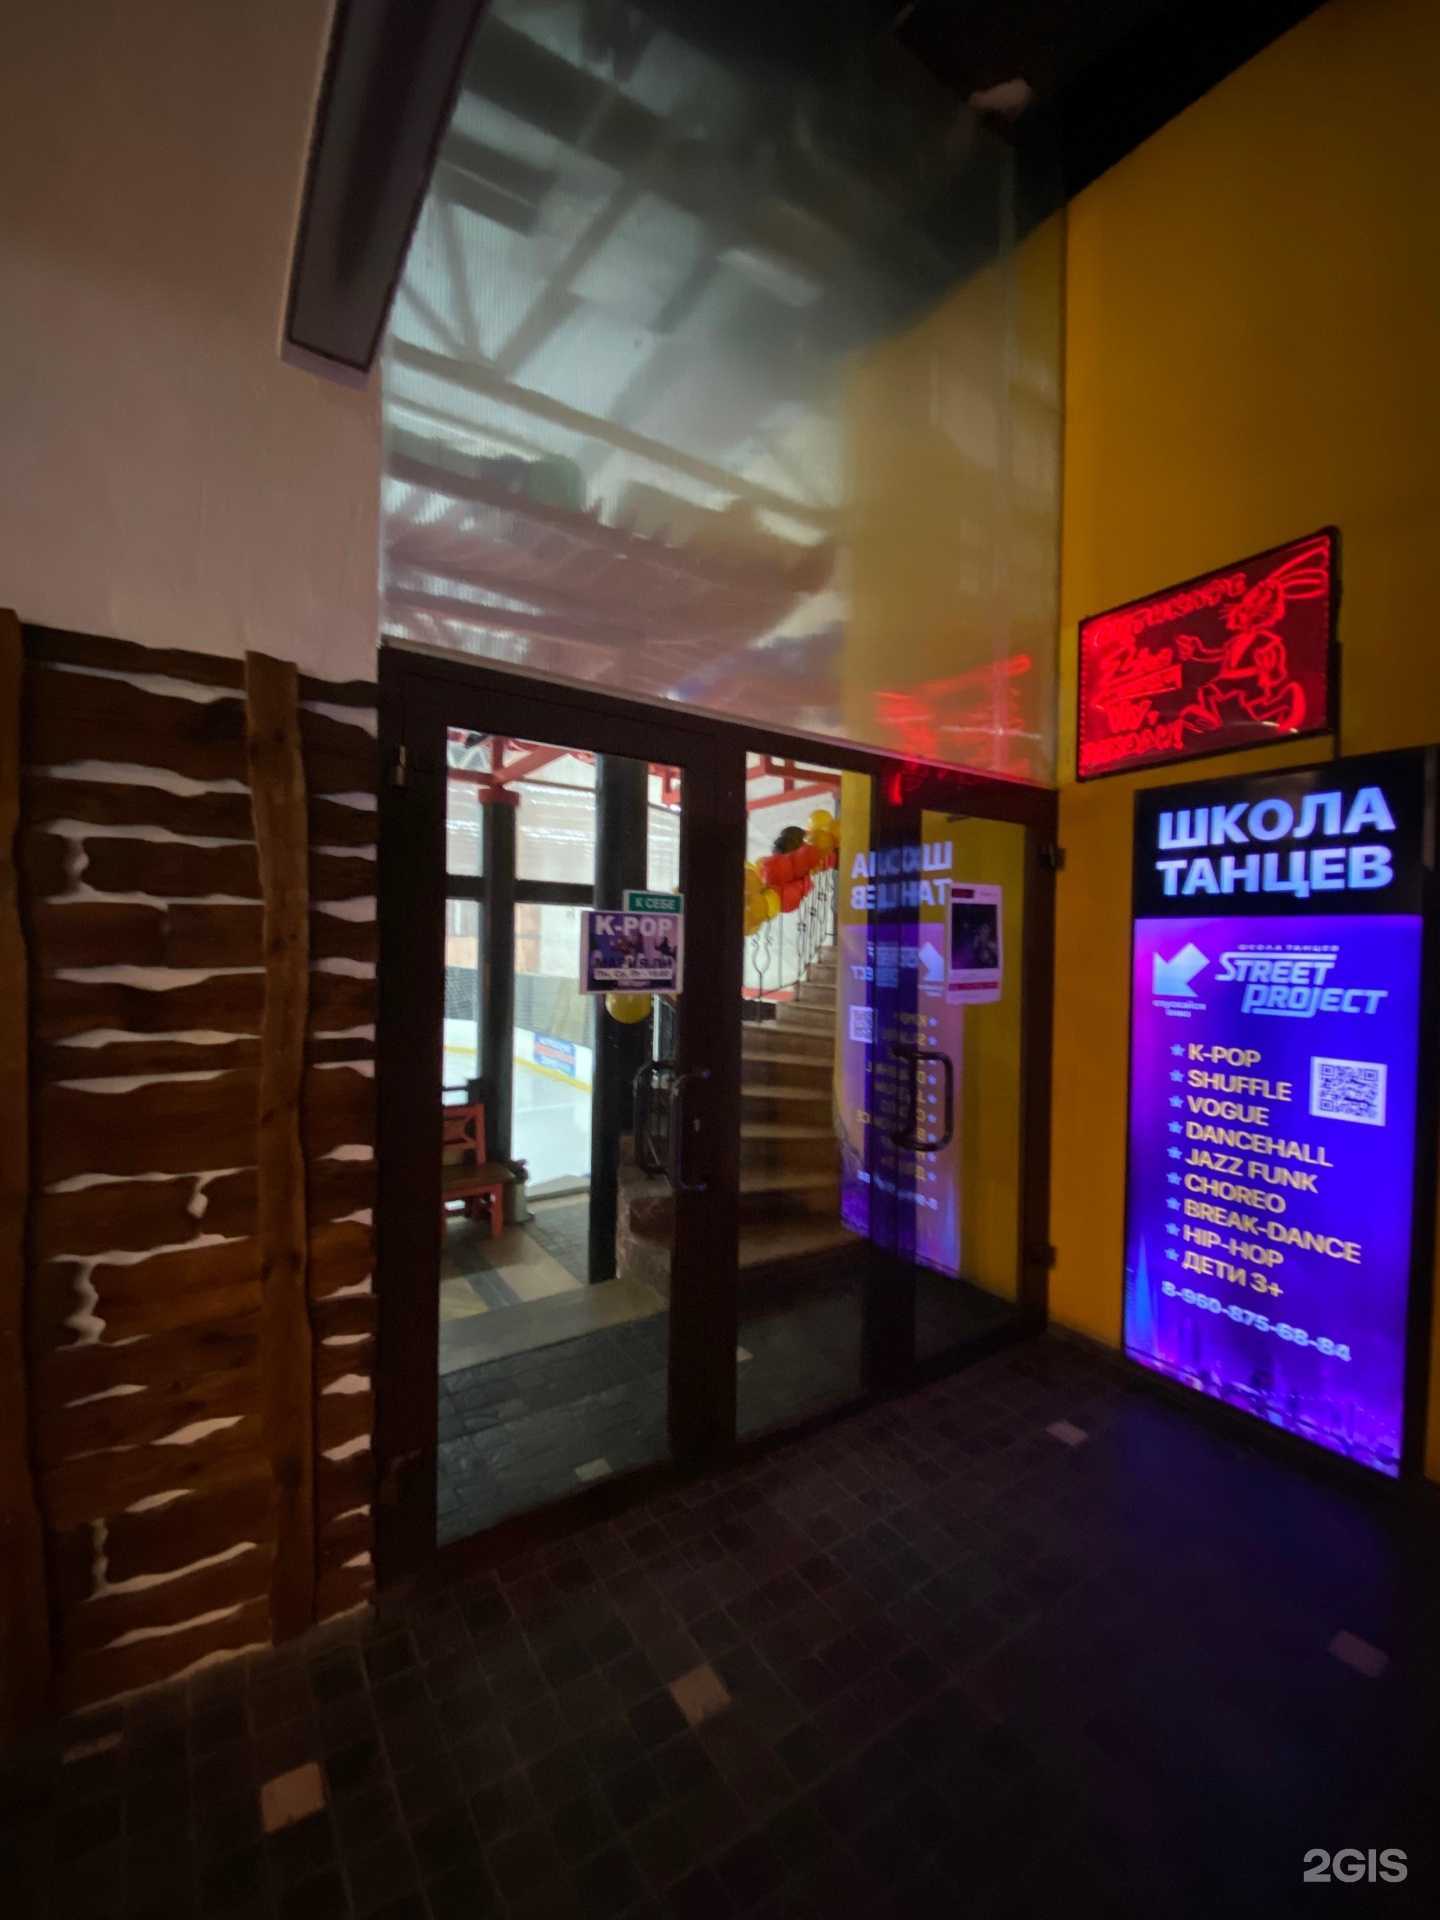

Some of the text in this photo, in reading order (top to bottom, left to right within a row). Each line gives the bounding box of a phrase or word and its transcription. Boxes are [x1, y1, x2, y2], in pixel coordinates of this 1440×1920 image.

[1158, 787, 1396, 850] ШКОЛА
[1155, 845, 1394, 898] ТАНЦЕВ
[595, 915, 672, 937] K-POP
[1214, 951, 1338, 984] STREET
[1241, 983, 1389, 1018] PROJECT
[1188, 1043, 1261, 1068] K-POP
[1187, 1069, 1292, 1101] SHUFFLE
[1186, 1095, 1269, 1127] VOGUE
[1185, 1121, 1334, 1168] DANCEHALL
[1184, 1147, 1319, 1193] JAZZ FUNK
[1184, 1173, 1287, 1214] CHOREO
[1182, 1225, 1285, 1269] HIP-HOP
[1183, 1199, 1362, 1265] BREAK-DANCE
[1181, 1250, 1284, 1298] ДЕТИ 3+
